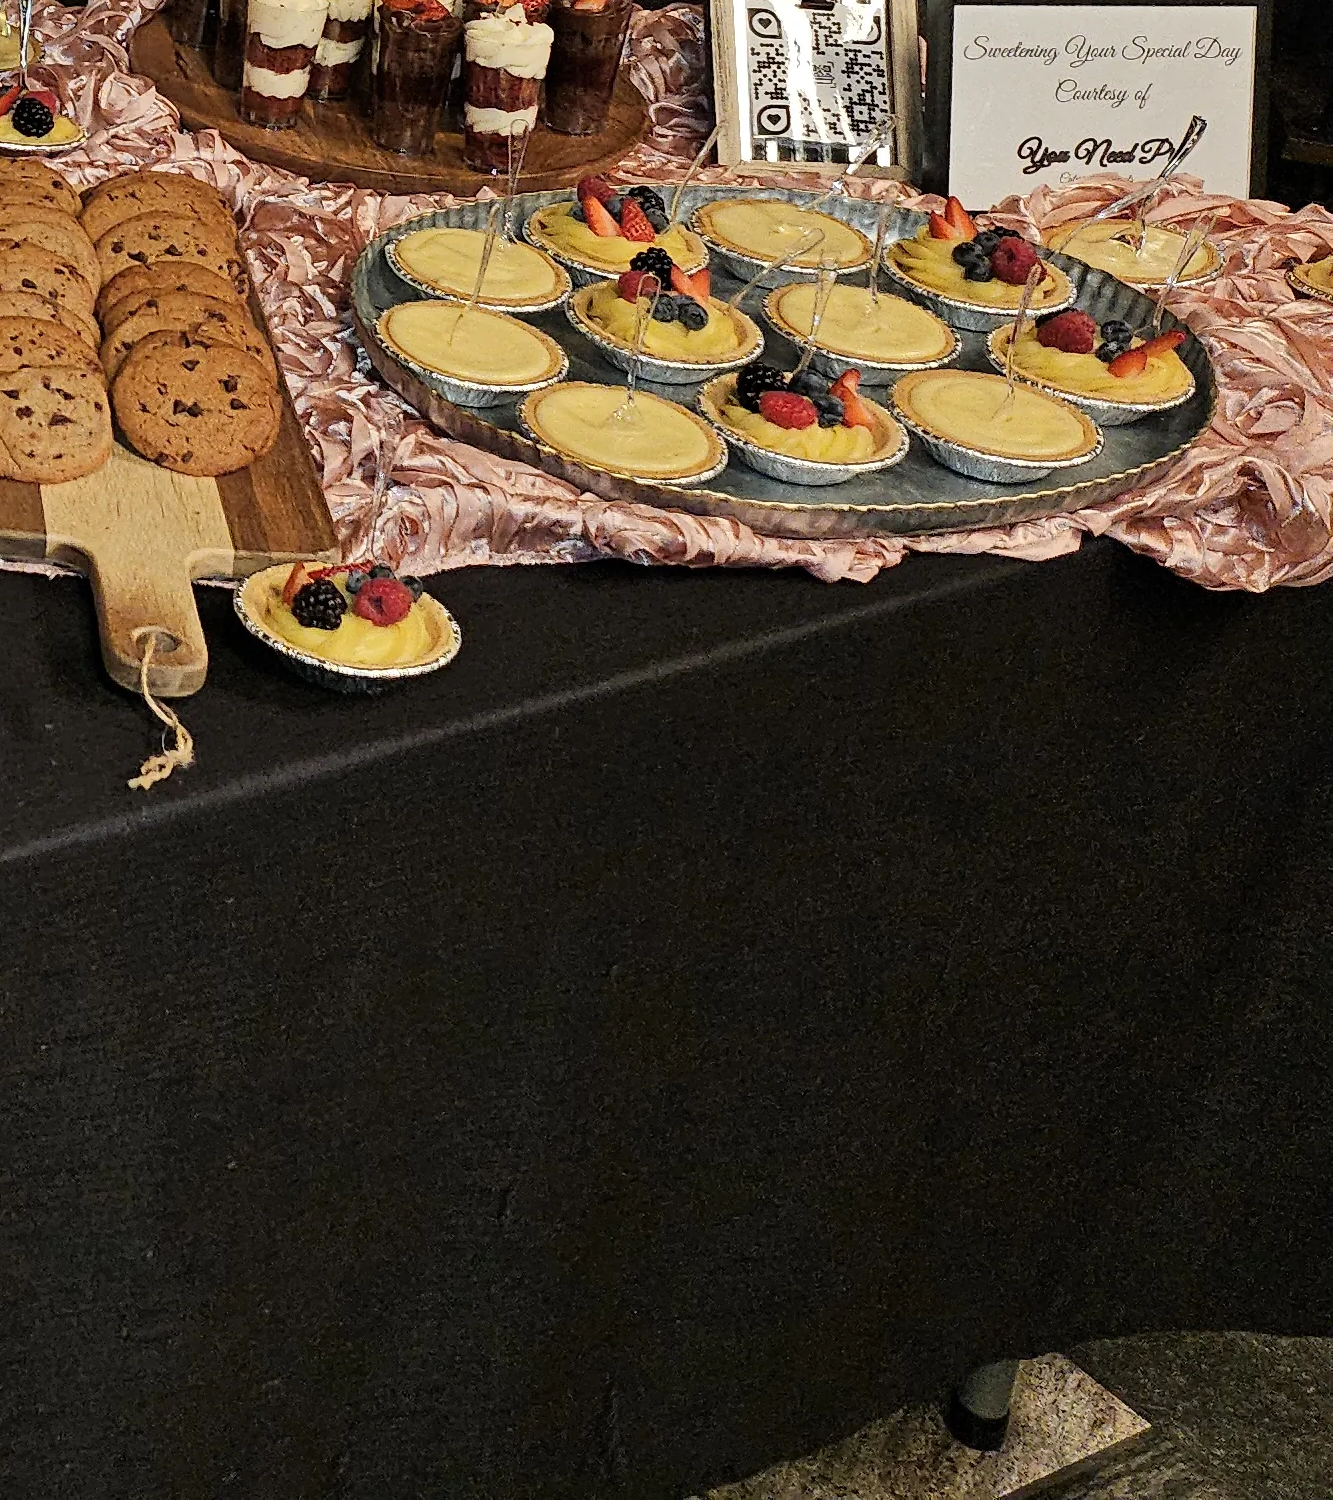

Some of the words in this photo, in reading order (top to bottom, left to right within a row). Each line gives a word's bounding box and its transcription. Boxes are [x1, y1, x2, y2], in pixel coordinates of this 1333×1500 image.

[964, 35, 1058, 66] Sweetening
[1064, 34, 1117, 68] Your
[1121, 35, 1190, 68] Special
[1194, 36, 1242, 66] Day
[1054, 78, 1129, 109] Courtesy
[1134, 83, 1153, 109] of
[1017, 136, 1070, 175] You
[1074, 137, 1137, 168] Need
